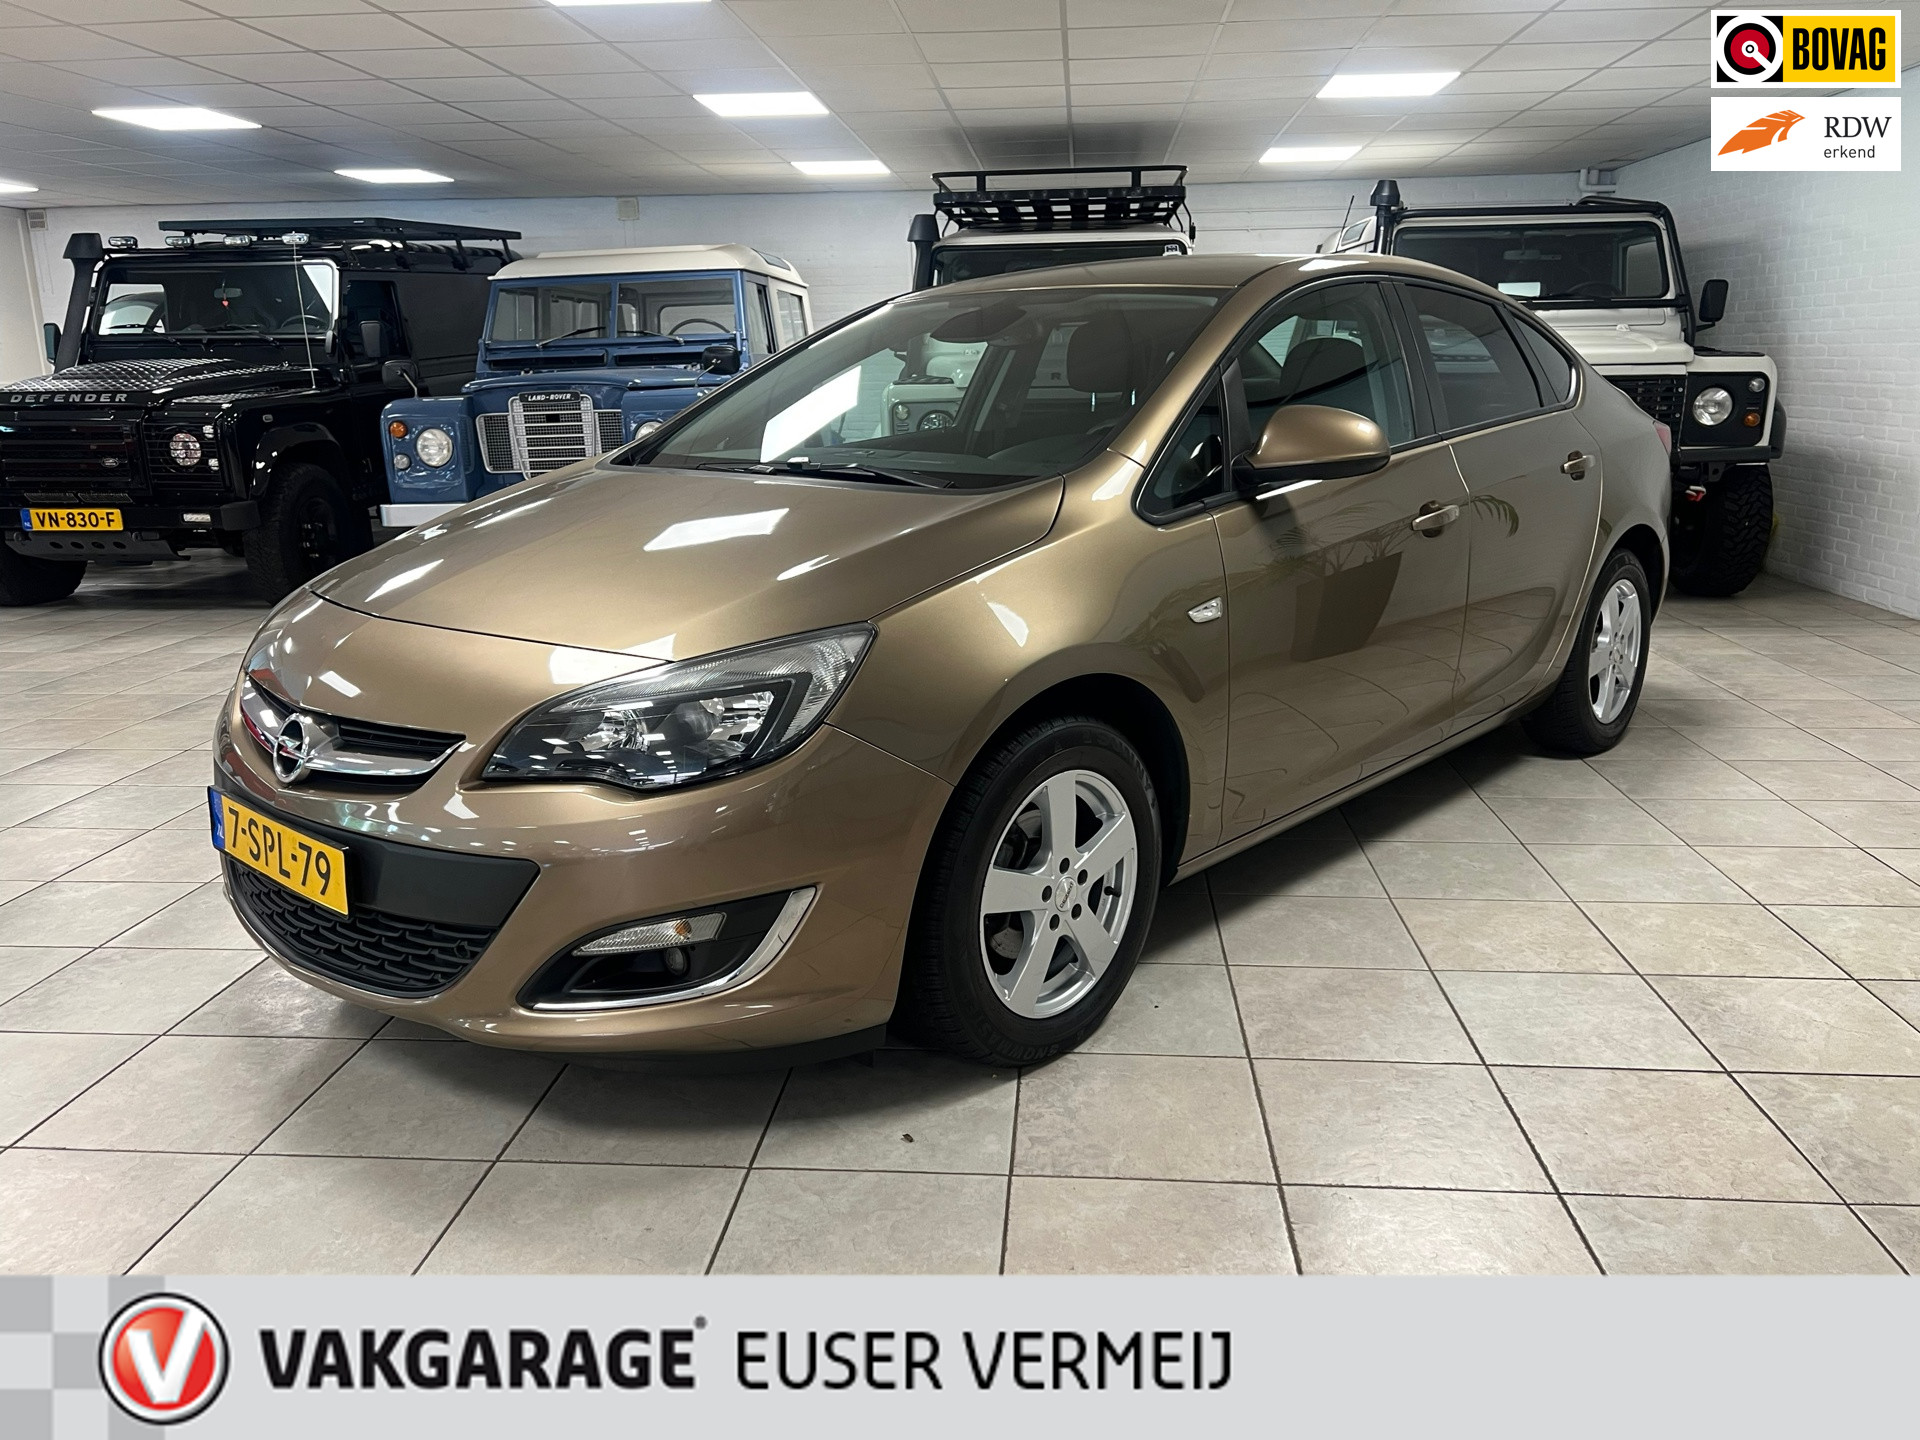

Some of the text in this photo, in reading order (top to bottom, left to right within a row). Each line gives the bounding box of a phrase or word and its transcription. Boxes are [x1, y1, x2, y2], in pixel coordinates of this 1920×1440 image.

[10, 393, 128, 403] DEFENDER
[35, 511, 115, 528] VN-830-F
[228, 808, 331, 896] 7-SPL-79
